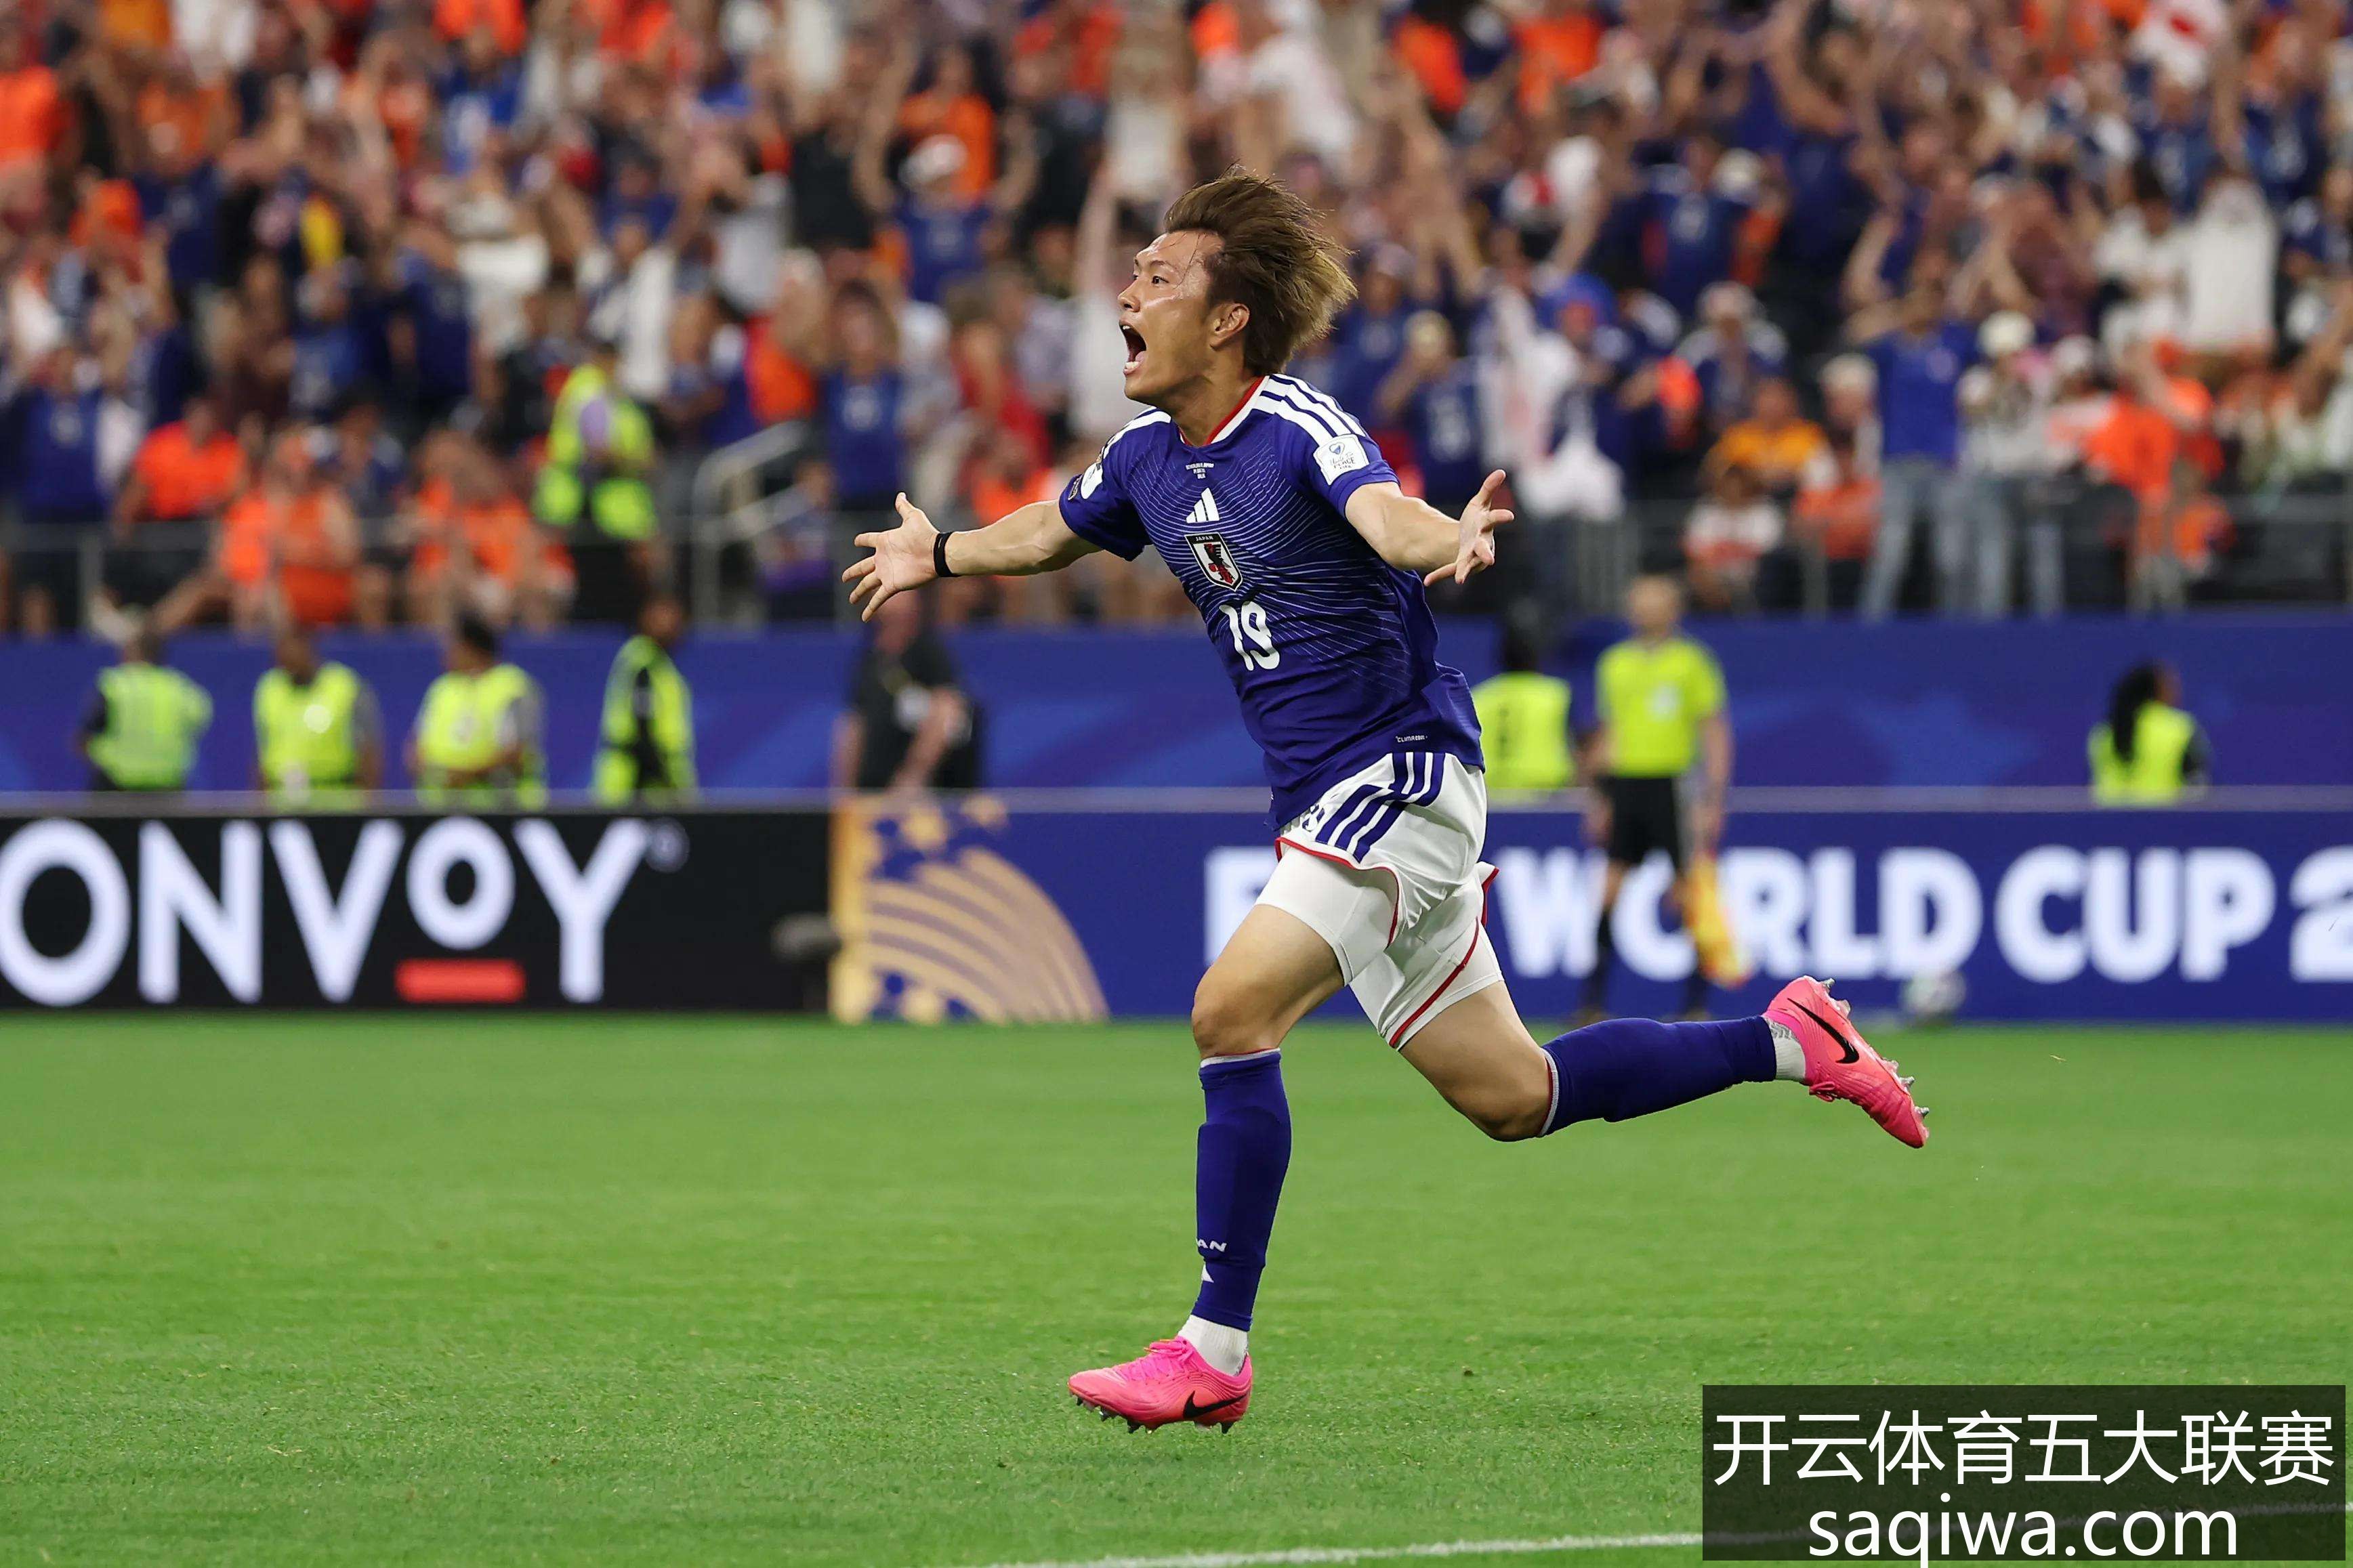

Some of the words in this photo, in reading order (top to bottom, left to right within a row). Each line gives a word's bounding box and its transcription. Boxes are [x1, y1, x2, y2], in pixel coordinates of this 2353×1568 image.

[1219, 601, 1280, 671] 19
[0, 817, 648, 1004] ONVOY
[1995, 846, 2275, 982] CUP
[1196, 1238, 1227, 1252] AN
